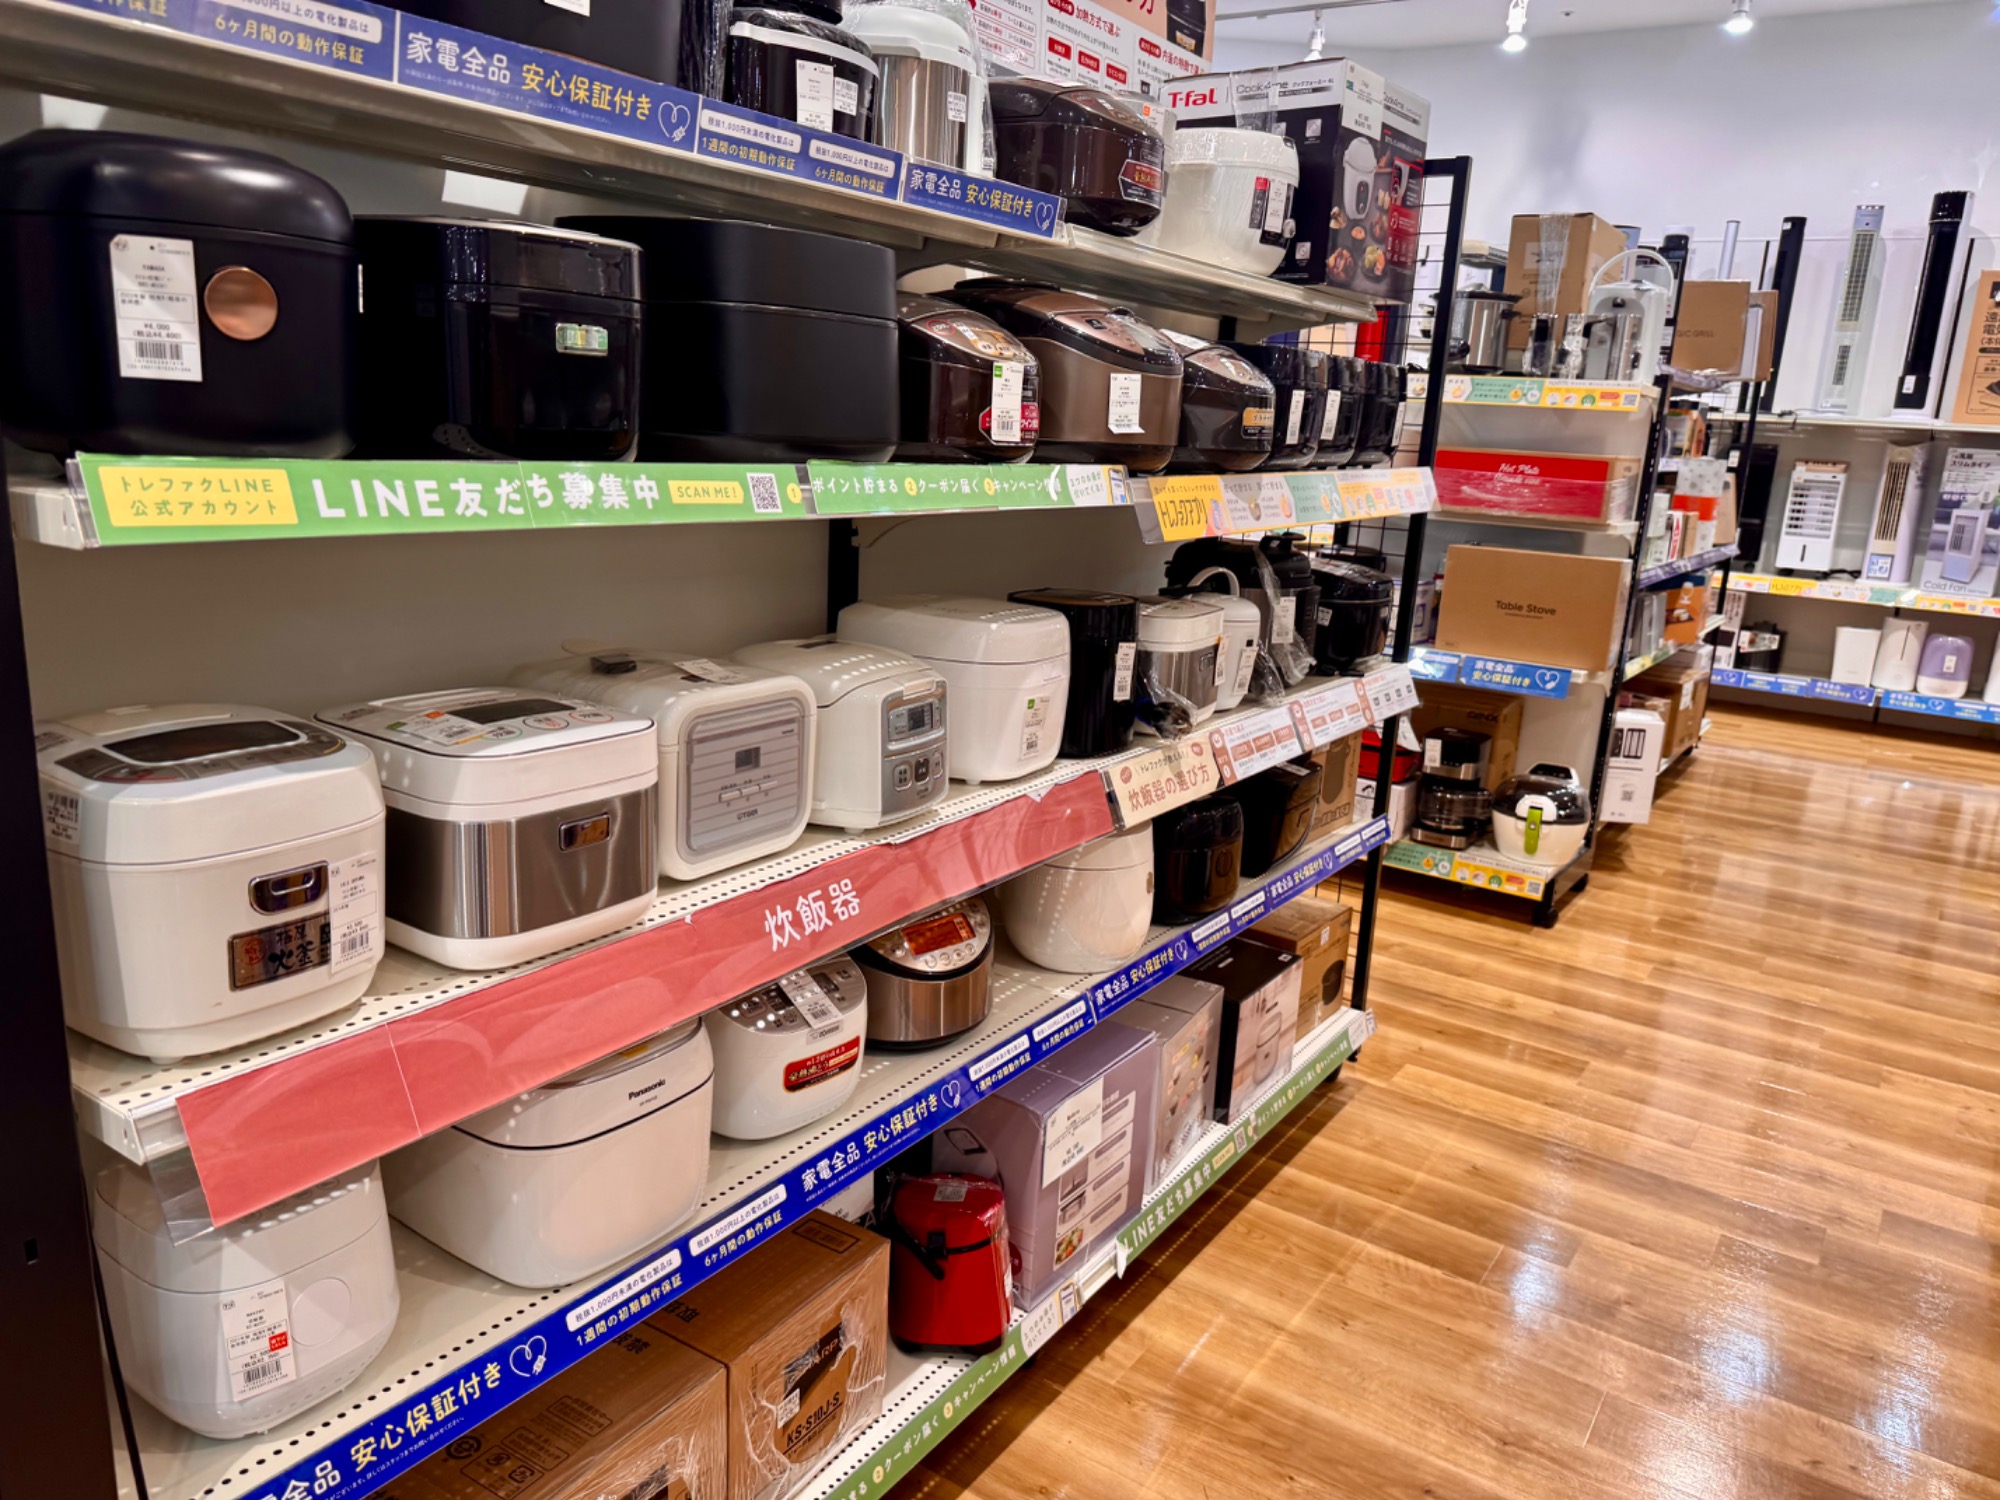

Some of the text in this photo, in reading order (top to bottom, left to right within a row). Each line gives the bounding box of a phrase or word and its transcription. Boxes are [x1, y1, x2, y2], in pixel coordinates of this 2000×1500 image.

[215, 16, 365, 65] 6ヶ月間の動作保証
[407, 32, 511, 84] 家電全品
[522, 63, 652, 121] 安心保証付き
[1168, 88, 1218, 109] T-fal
[910, 168, 962, 200] 家電全品
[965, 183, 1034, 218] 安心保証付き
[120, 476, 274, 494] トレファクLINE
[130, 499, 277, 518] 公式アカウント
[311, 472, 660, 519] LINE友だち募集中
[677, 485, 739, 499] SCAN ME!
[813, 477, 899, 495] ポイント貯まる
[917, 477, 980, 495] クーポン届く
[1496, 600, 1557, 616] Table Stove
[1128, 763, 1210, 812] 炊飯器の選び方
[765, 878, 860, 952] 炊飯器
[268, 941, 317, 974] 火釜
[628, 1078, 666, 1101] Panasonic
[801, 1142, 861, 1192] 家電全品
[862, 1093, 938, 1153] 安心保証付き
[704, 1209, 783, 1267] 6ヶ月間の動作保証
[576, 1273, 683, 1347] 1週間の初期動作保証
[350, 1361, 501, 1472] 安心保証付き
[786, 1391, 841, 1446] KS-S10J-S
[884, 1415, 940, 1474] クーポン届く
[953, 1344, 1017, 1408] キャンペーン情報
